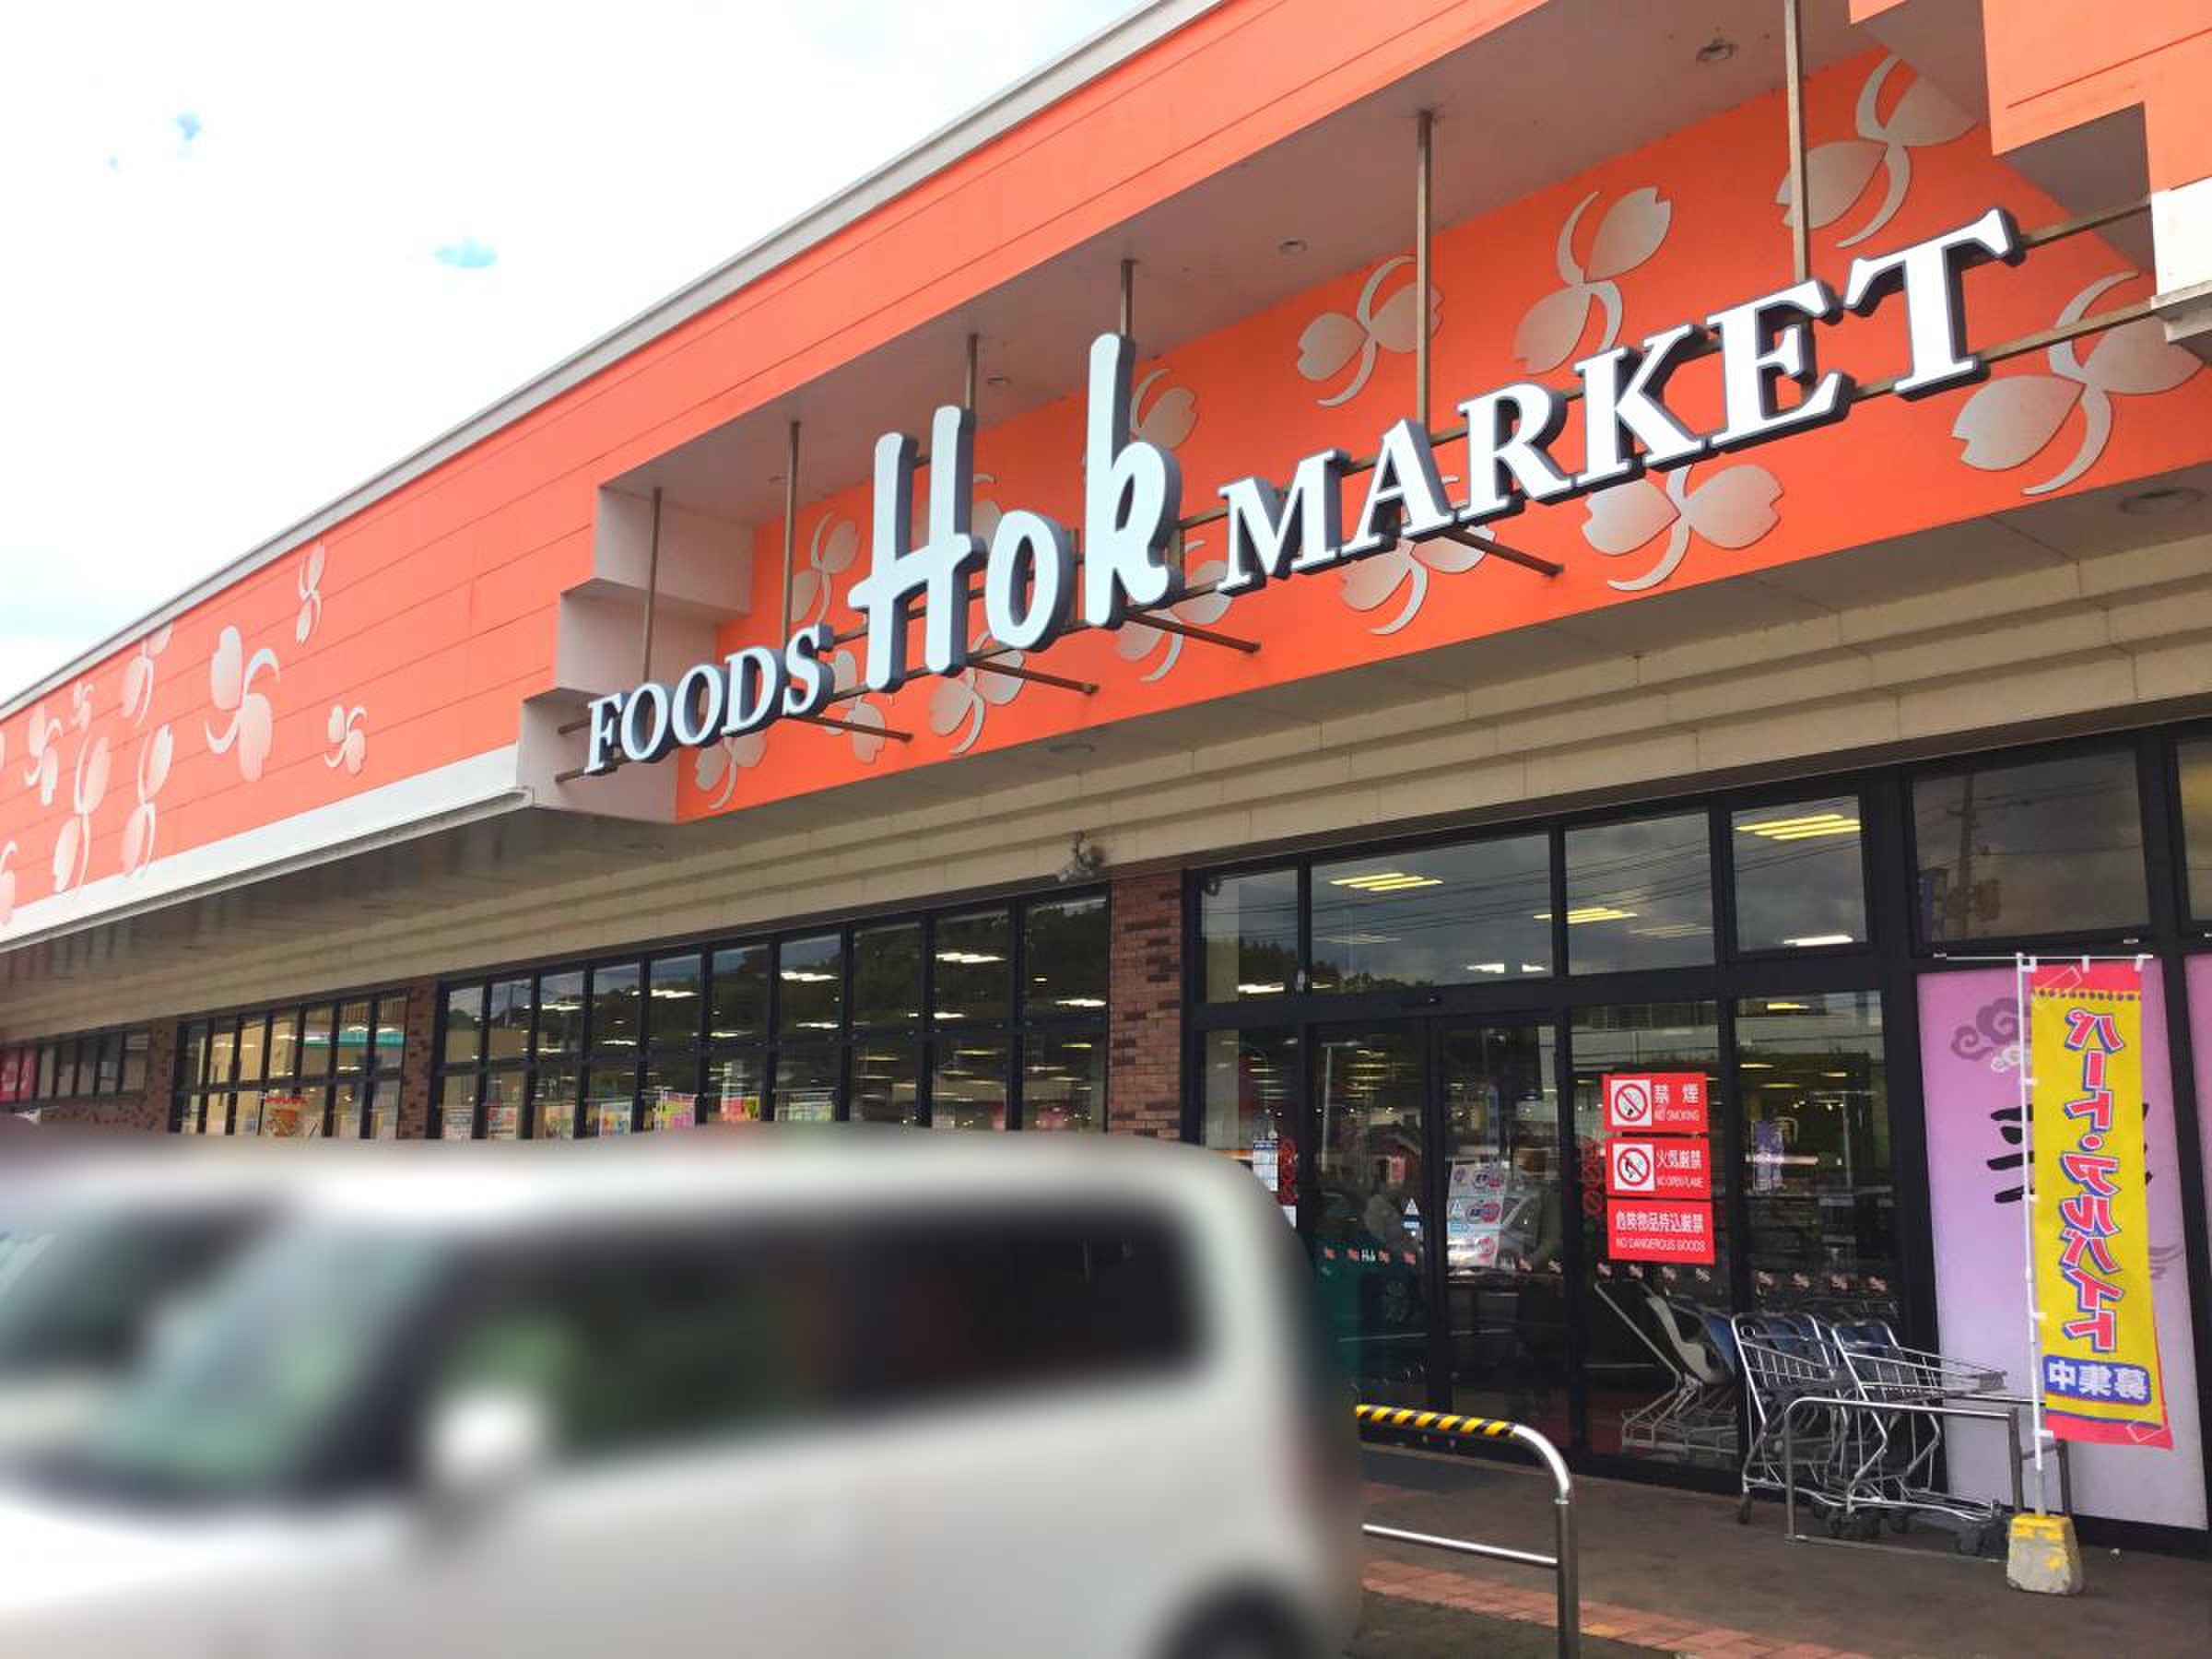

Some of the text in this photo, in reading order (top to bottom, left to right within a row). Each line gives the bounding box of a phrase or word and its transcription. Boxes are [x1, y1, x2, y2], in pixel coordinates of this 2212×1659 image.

[584, 208, 2024, 775] FOODS Hok MARKET
[1666, 1109, 1700, 1122] SMOKING
[1629, 1237, 1675, 1252] DANGEROUS
[1677, 1239, 1705, 1253] GOODS
